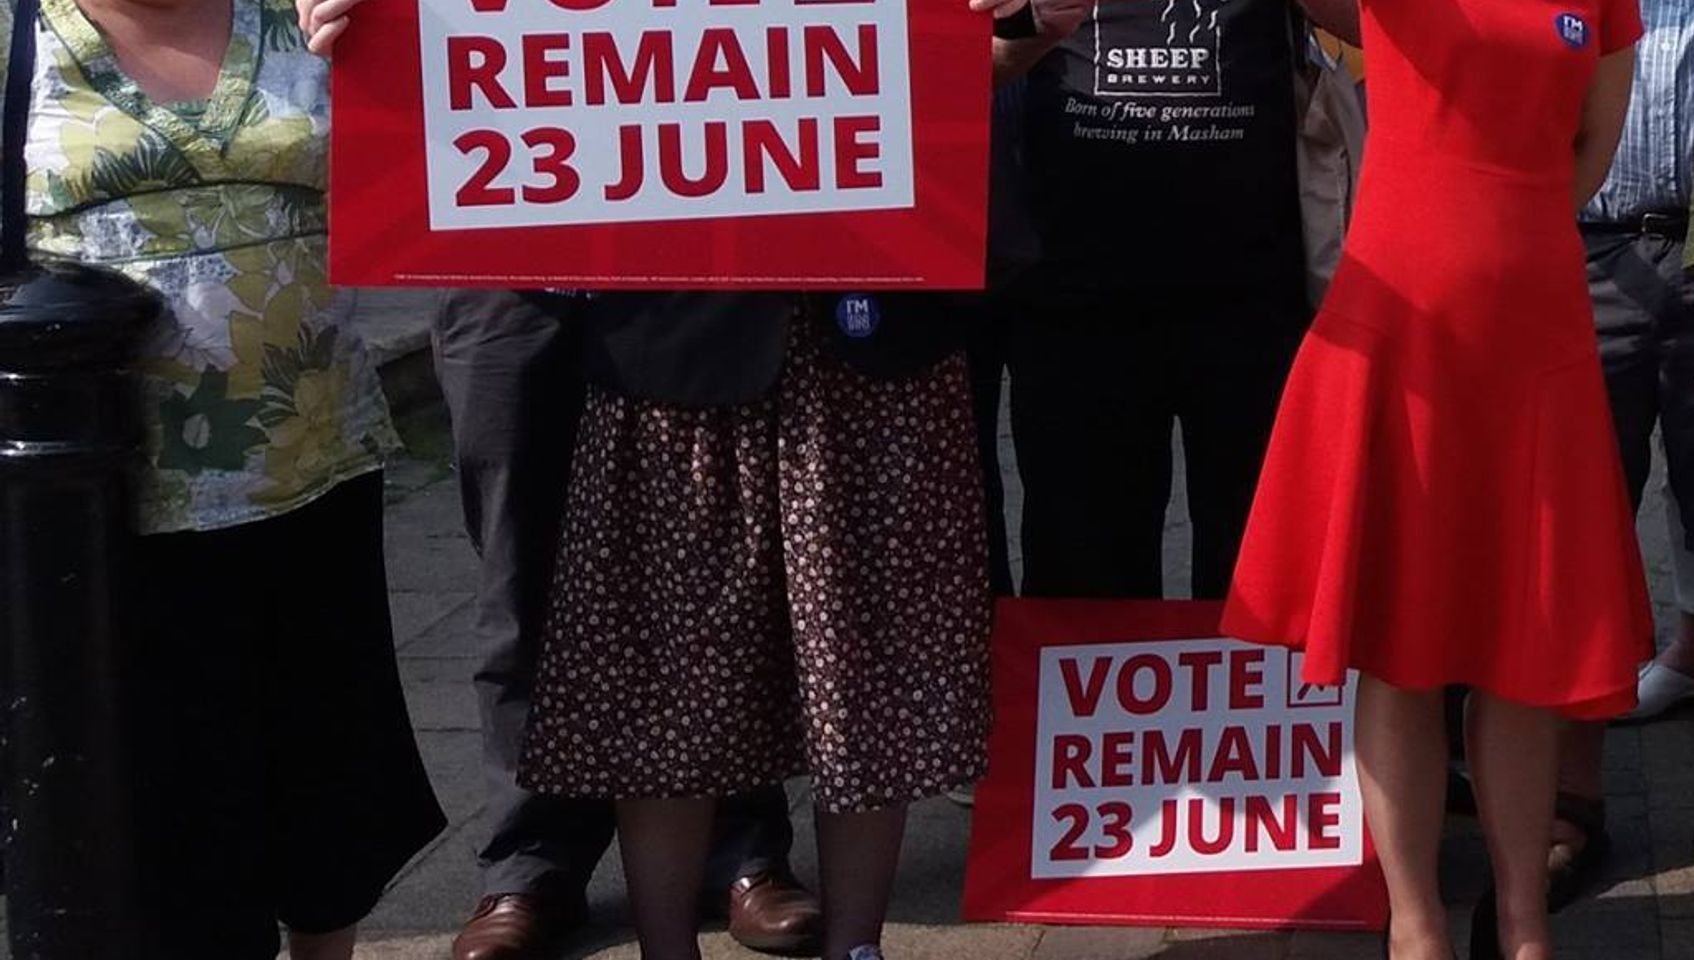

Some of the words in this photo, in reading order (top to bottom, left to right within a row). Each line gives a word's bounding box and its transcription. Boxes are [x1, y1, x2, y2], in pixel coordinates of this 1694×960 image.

[446, 24, 880, 112] REMAIN
[1106, 48, 1210, 69] SHEEP
[1107, 74, 1211, 84] BREWERY
[1065, 97, 1098, 115] Born
[1101, 101, 1121, 120] of
[1120, 101, 1156, 122] five
[1160, 102, 1255, 123] generations
[1074, 122, 1140, 145] brewing
[1144, 125, 1162, 141] in
[1167, 124, 1244, 141] Masham
[453, 126, 581, 208] 23
[604, 115, 883, 202] JUNE
[1058, 649, 1265, 717] VOTE
[1051, 722, 1342, 789] REMAIN
[1049, 801, 1134, 861] 23
[1150, 793, 1341, 858] JUNE
